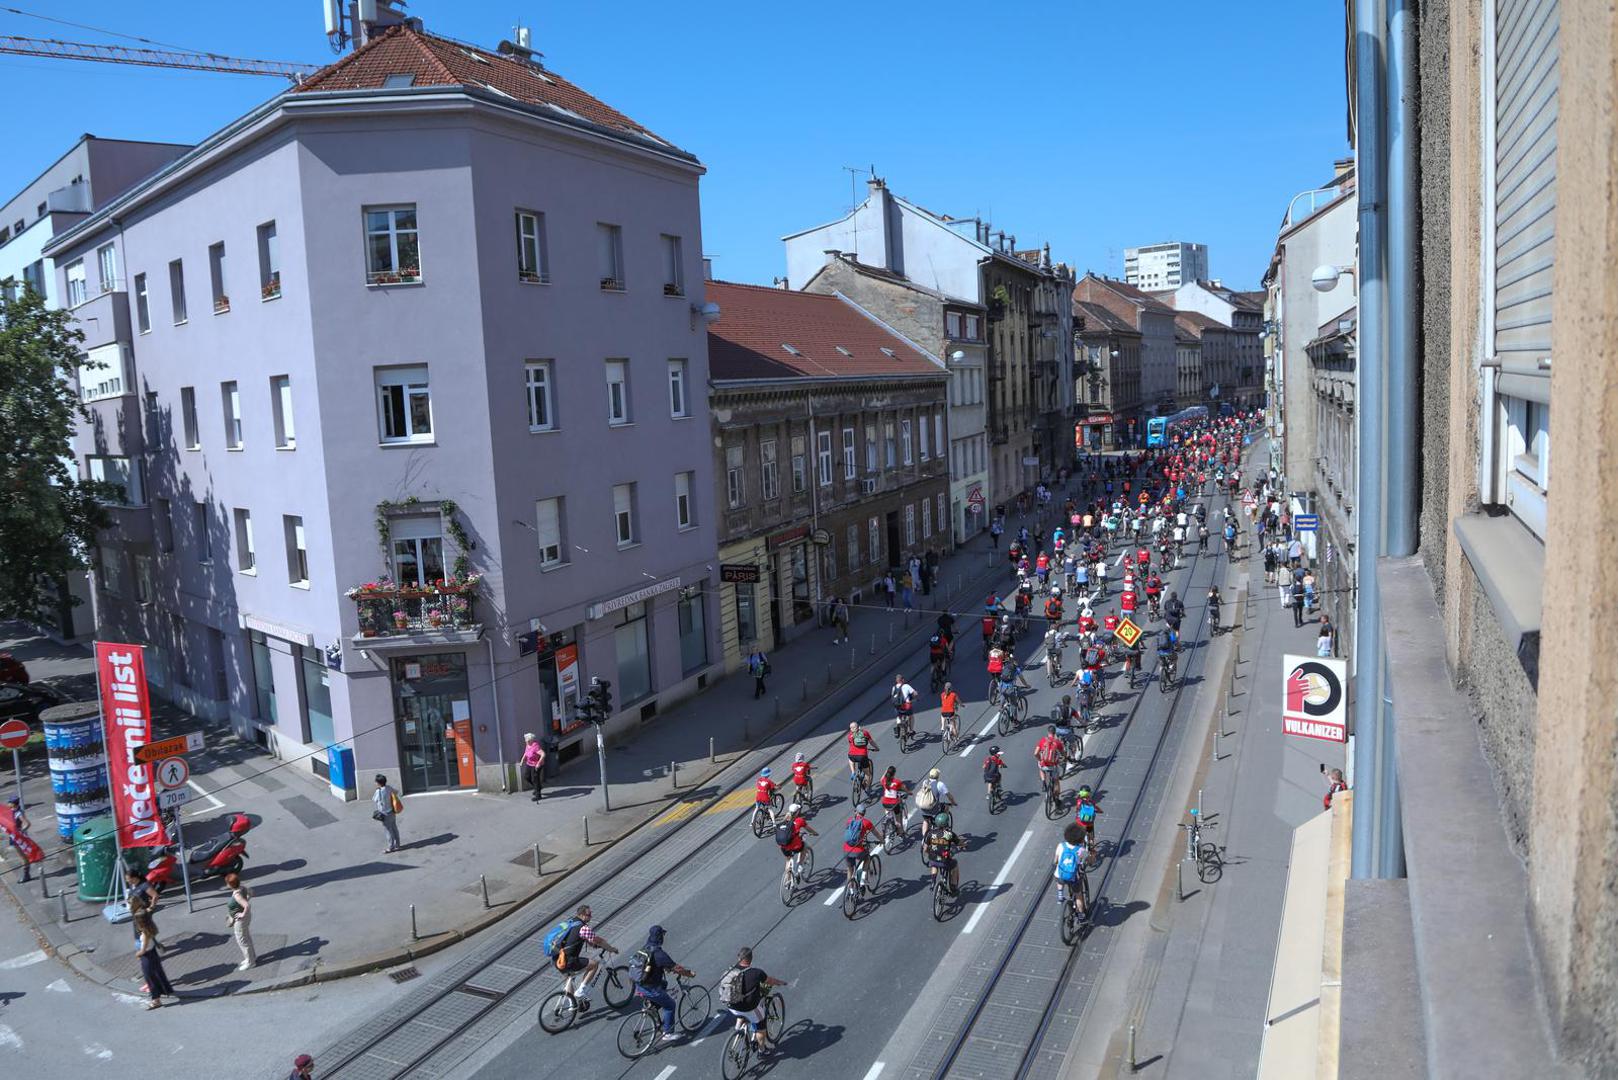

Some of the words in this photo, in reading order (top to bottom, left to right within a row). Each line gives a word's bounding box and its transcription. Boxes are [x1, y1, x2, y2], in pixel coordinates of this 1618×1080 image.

[108, 652, 138, 702] list
[1284, 719, 1344, 741] VULKANIZER
[166, 793, 177, 804] 70
